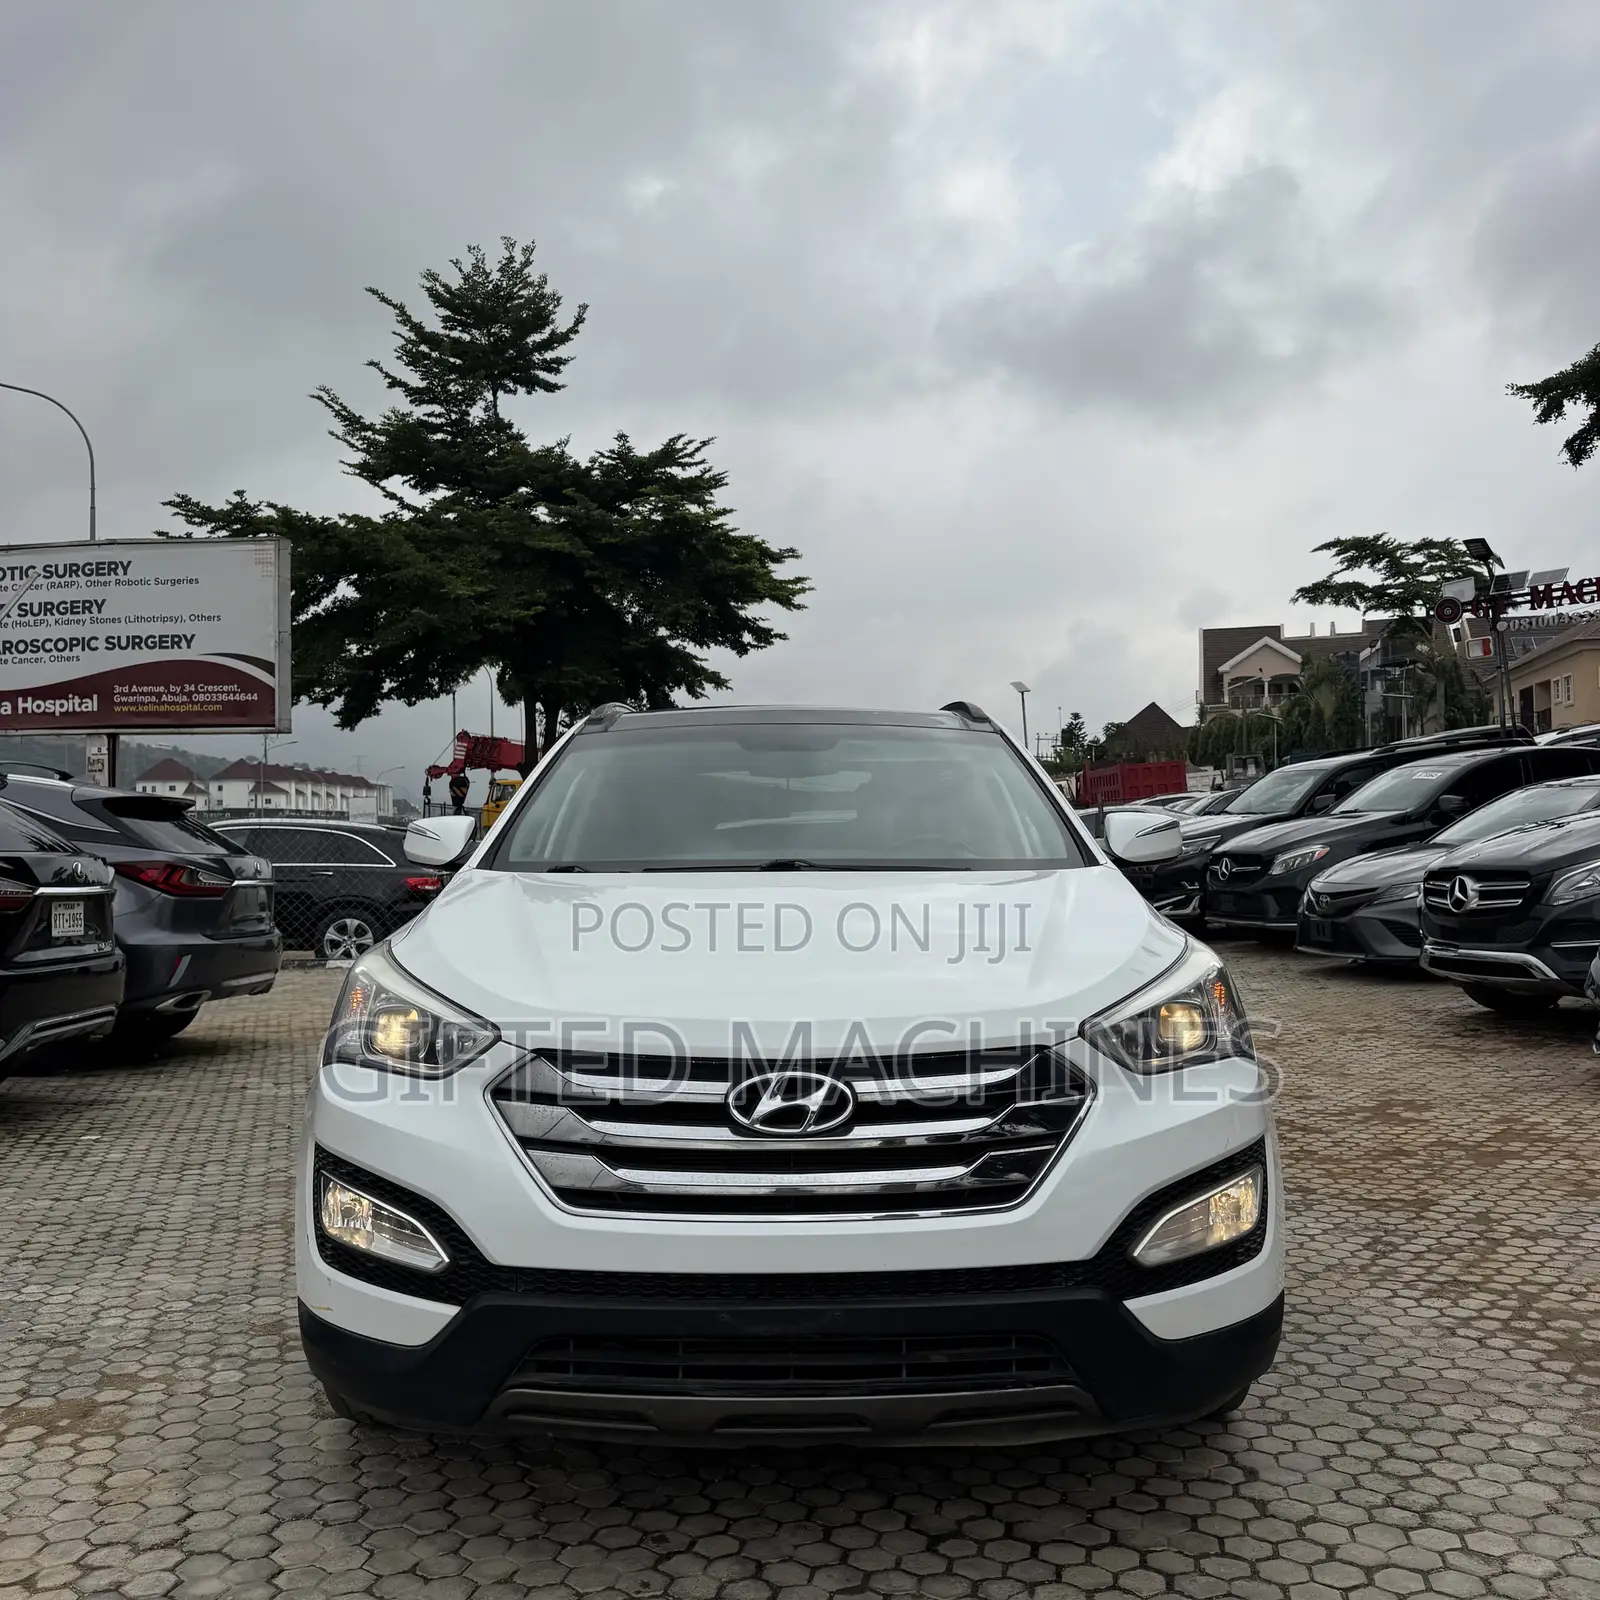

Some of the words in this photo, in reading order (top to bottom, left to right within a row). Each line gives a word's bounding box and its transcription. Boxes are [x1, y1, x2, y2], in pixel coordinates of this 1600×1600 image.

[42, 561, 132, 579] SURGERY
[85, 579, 112, 588] Other
[115, 578, 151, 587] Robotic
[154, 576, 199, 587] Surgeries
[17, 599, 107, 618] SURGERY
[54, 617, 87, 627] Kidney
[89, 615, 122, 625] Stones
[124, 614, 186, 625] (Lithotripsy),
[188, 613, 222, 623] Others
[0, 636, 99, 656] ROSCOPIC
[104, 634, 196, 651] SURGERY
[48, 654, 81, 663] Others
[113, 685, 129, 693] 3rd
[131, 685, 168, 694] Avenue,
[169, 684, 181, 694] by
[183, 684, 196, 692] 34
[197, 684, 241, 693] Crescent,
[113, 694, 159, 704] Gwarinpa,
[192, 693, 258, 702] 08033644644
[18, 694, 98, 717] Hospital
[113, 703, 223, 713] www.kelinahospital.com
